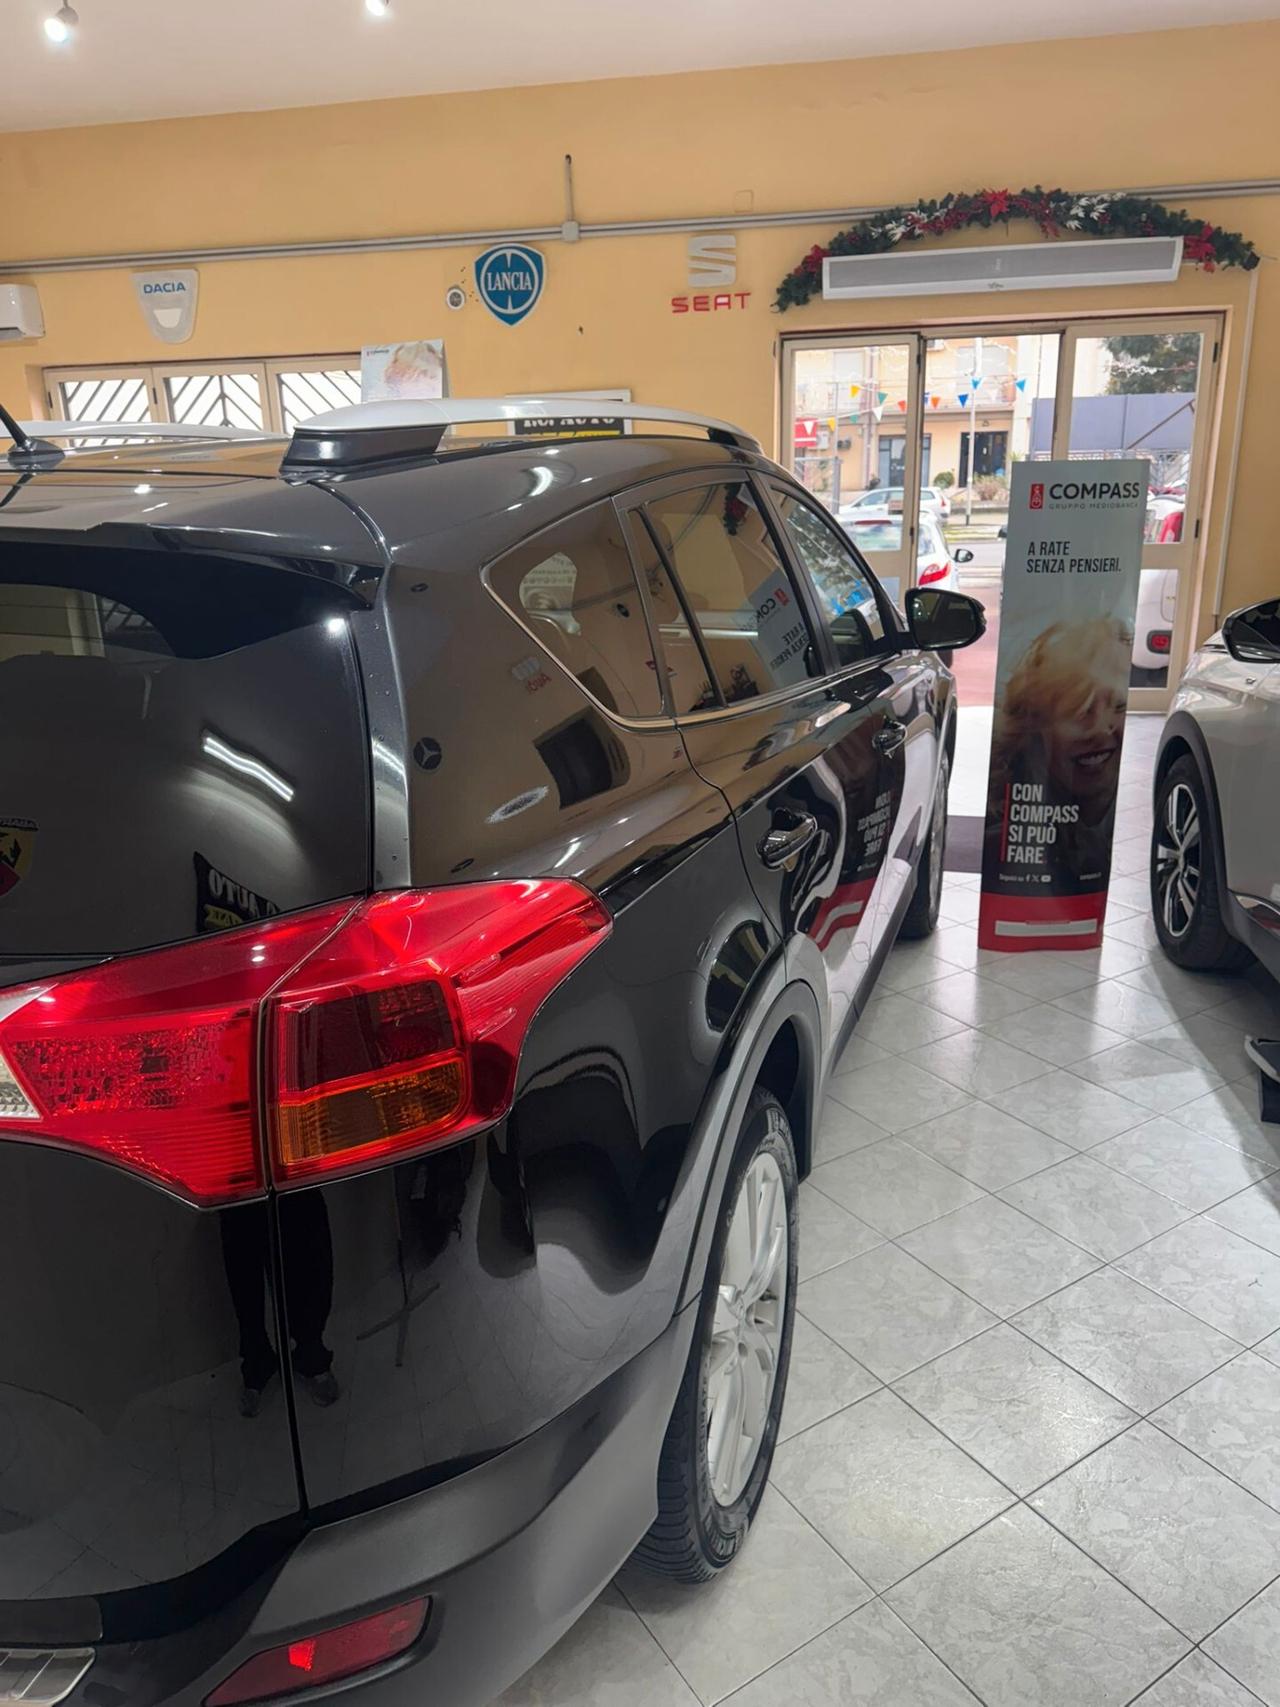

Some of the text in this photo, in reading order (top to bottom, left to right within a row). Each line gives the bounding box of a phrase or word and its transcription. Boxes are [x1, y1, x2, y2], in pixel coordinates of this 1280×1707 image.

[143, 281, 186, 294] DACIA
[487, 271, 532, 291] LANCIA
[671, 292, 751, 313] SEAT
[1049, 481, 1140, 500] COMPASS
[1027, 541, 1071, 556] A RATE
[1026, 557, 1122, 574] SENZA PENSIERI.
[1012, 783, 1043, 802] CON
[1010, 804, 1080, 824] COMPASS
[1008, 825, 1023, 843] SI
